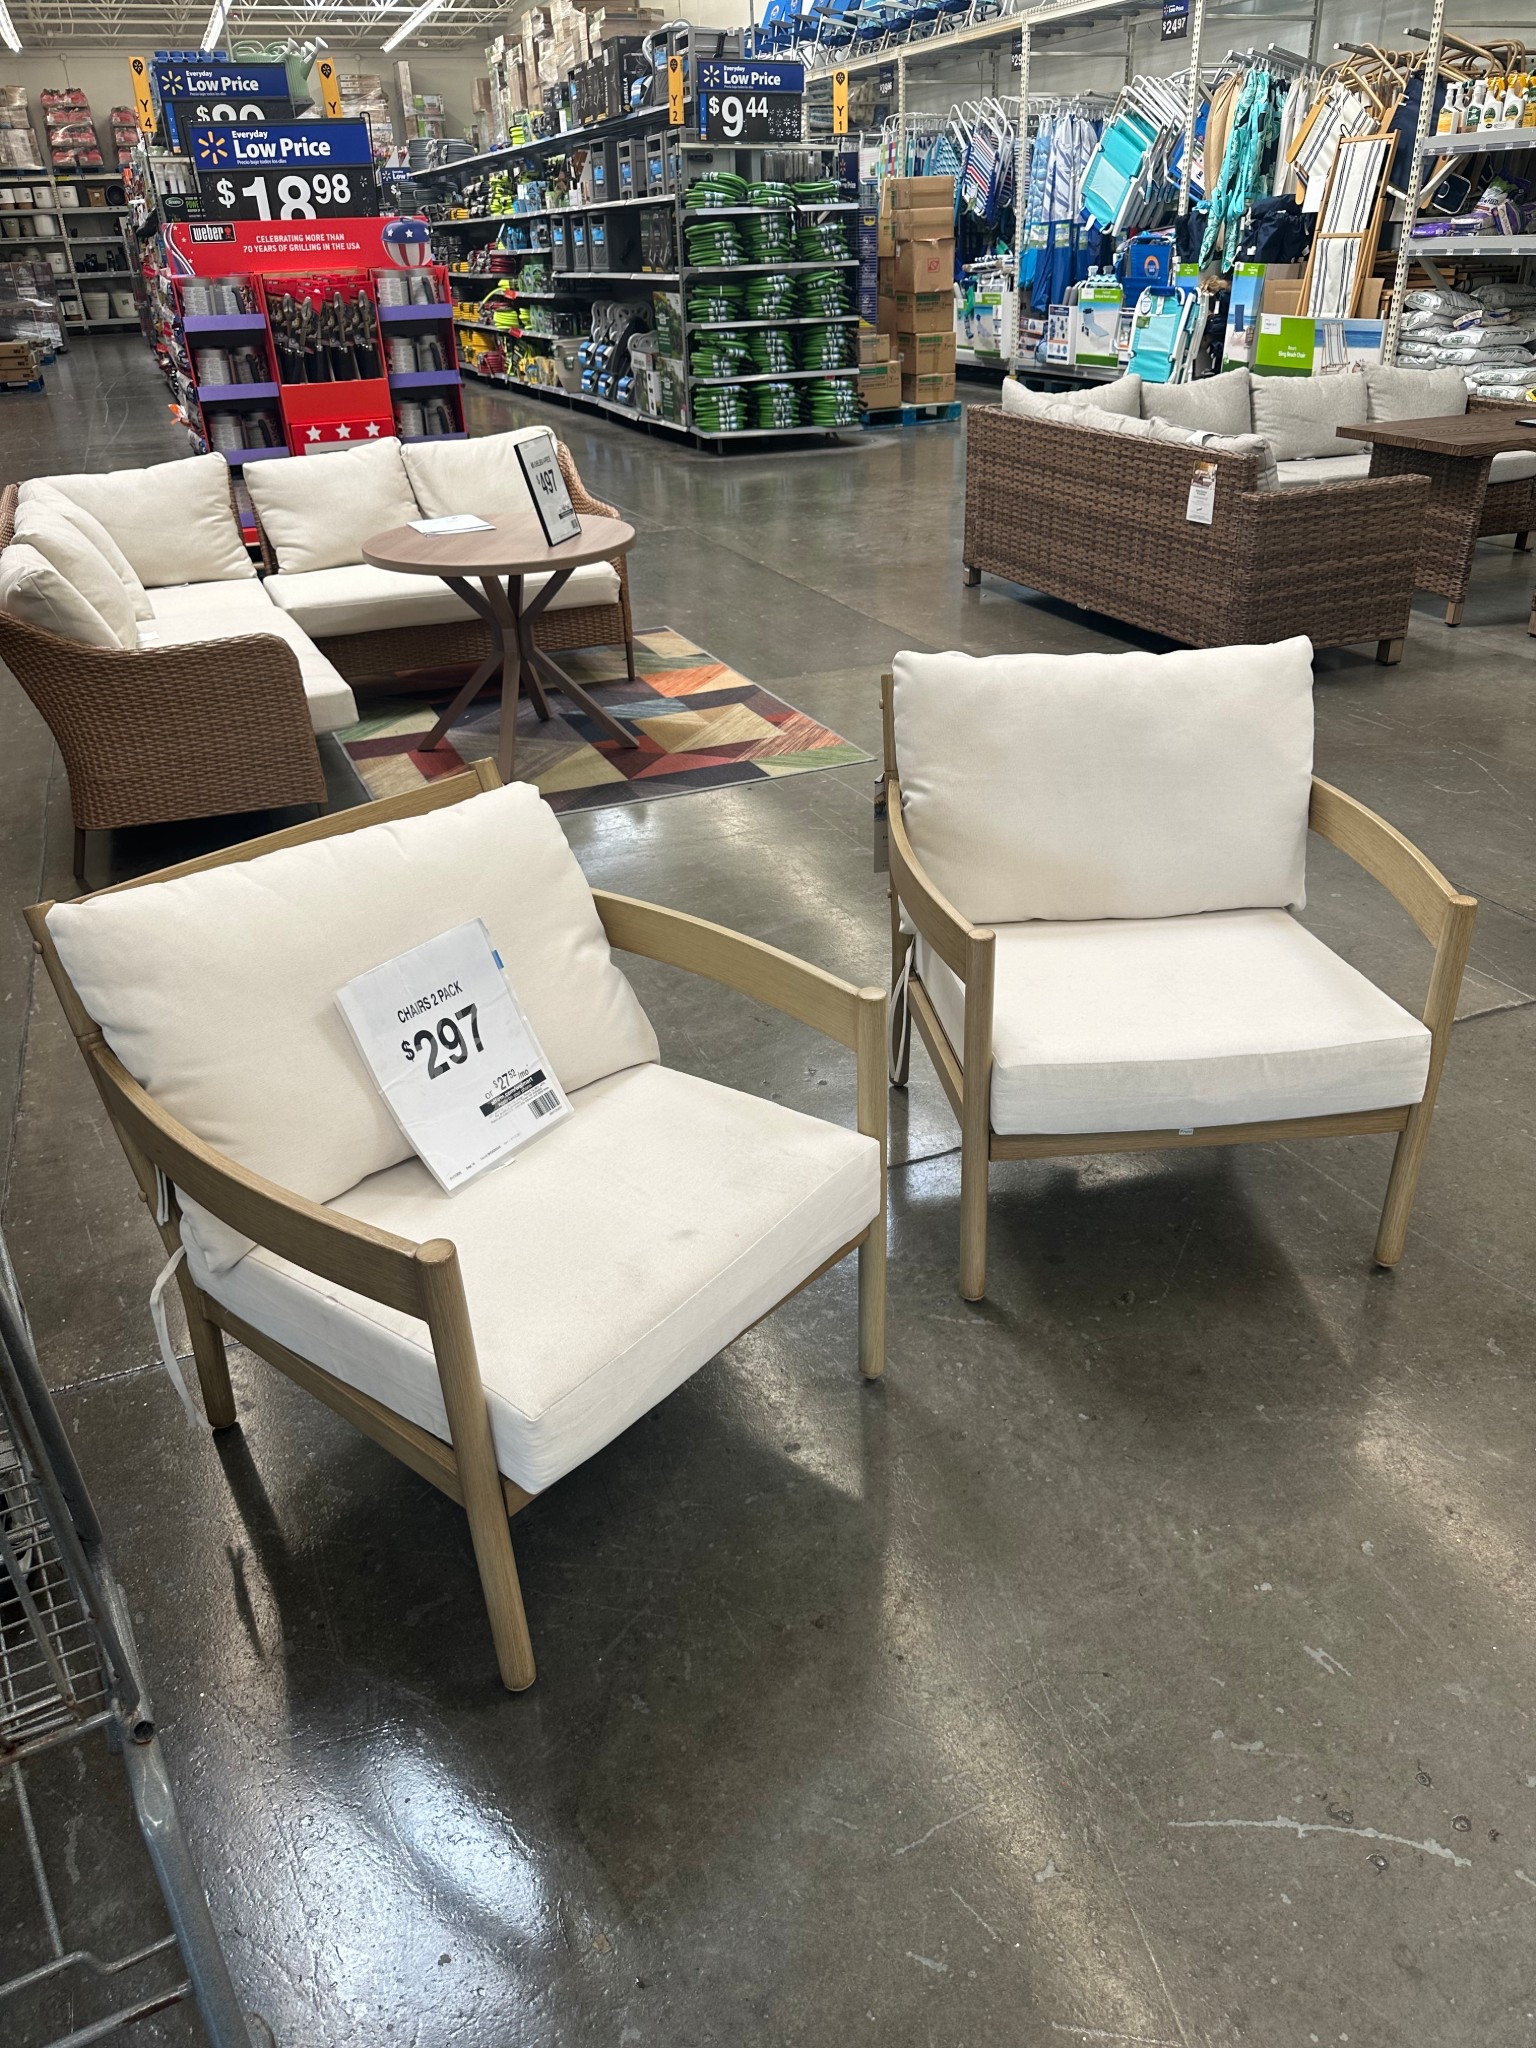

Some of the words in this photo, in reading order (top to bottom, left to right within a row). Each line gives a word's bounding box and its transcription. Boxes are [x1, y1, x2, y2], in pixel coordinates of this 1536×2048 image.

[186, 78, 220, 92] Low
[222, 76, 259, 91] Price
[724, 72, 748, 85] Low
[751, 72, 781, 86] Price
[140, 100, 149, 112] Y
[671, 94, 678, 106] Y
[328, 101, 337, 114] Y
[836, 106, 844, 117] Y
[144, 117, 152, 128] 4
[672, 111, 678, 122] 2
[838, 121, 843, 130] 1
[231, 130, 268, 139] Everyday
[234, 140, 276, 158] Low
[280, 137, 330, 157] Price
[192, 225, 223, 241] weber
[256, 234, 304, 243] CELEBRATING
[305, 234, 325, 242] MORE
[289, 243, 321, 252] GRILLING
[536, 469, 557, 495] $497
[397, 997, 432, 1023] CHAIRS
[431, 993, 439, 1006] 2
[437, 980, 463, 1002] PACK
[401, 1003, 484, 1080] $297
[485, 1090, 494, 1100] or
